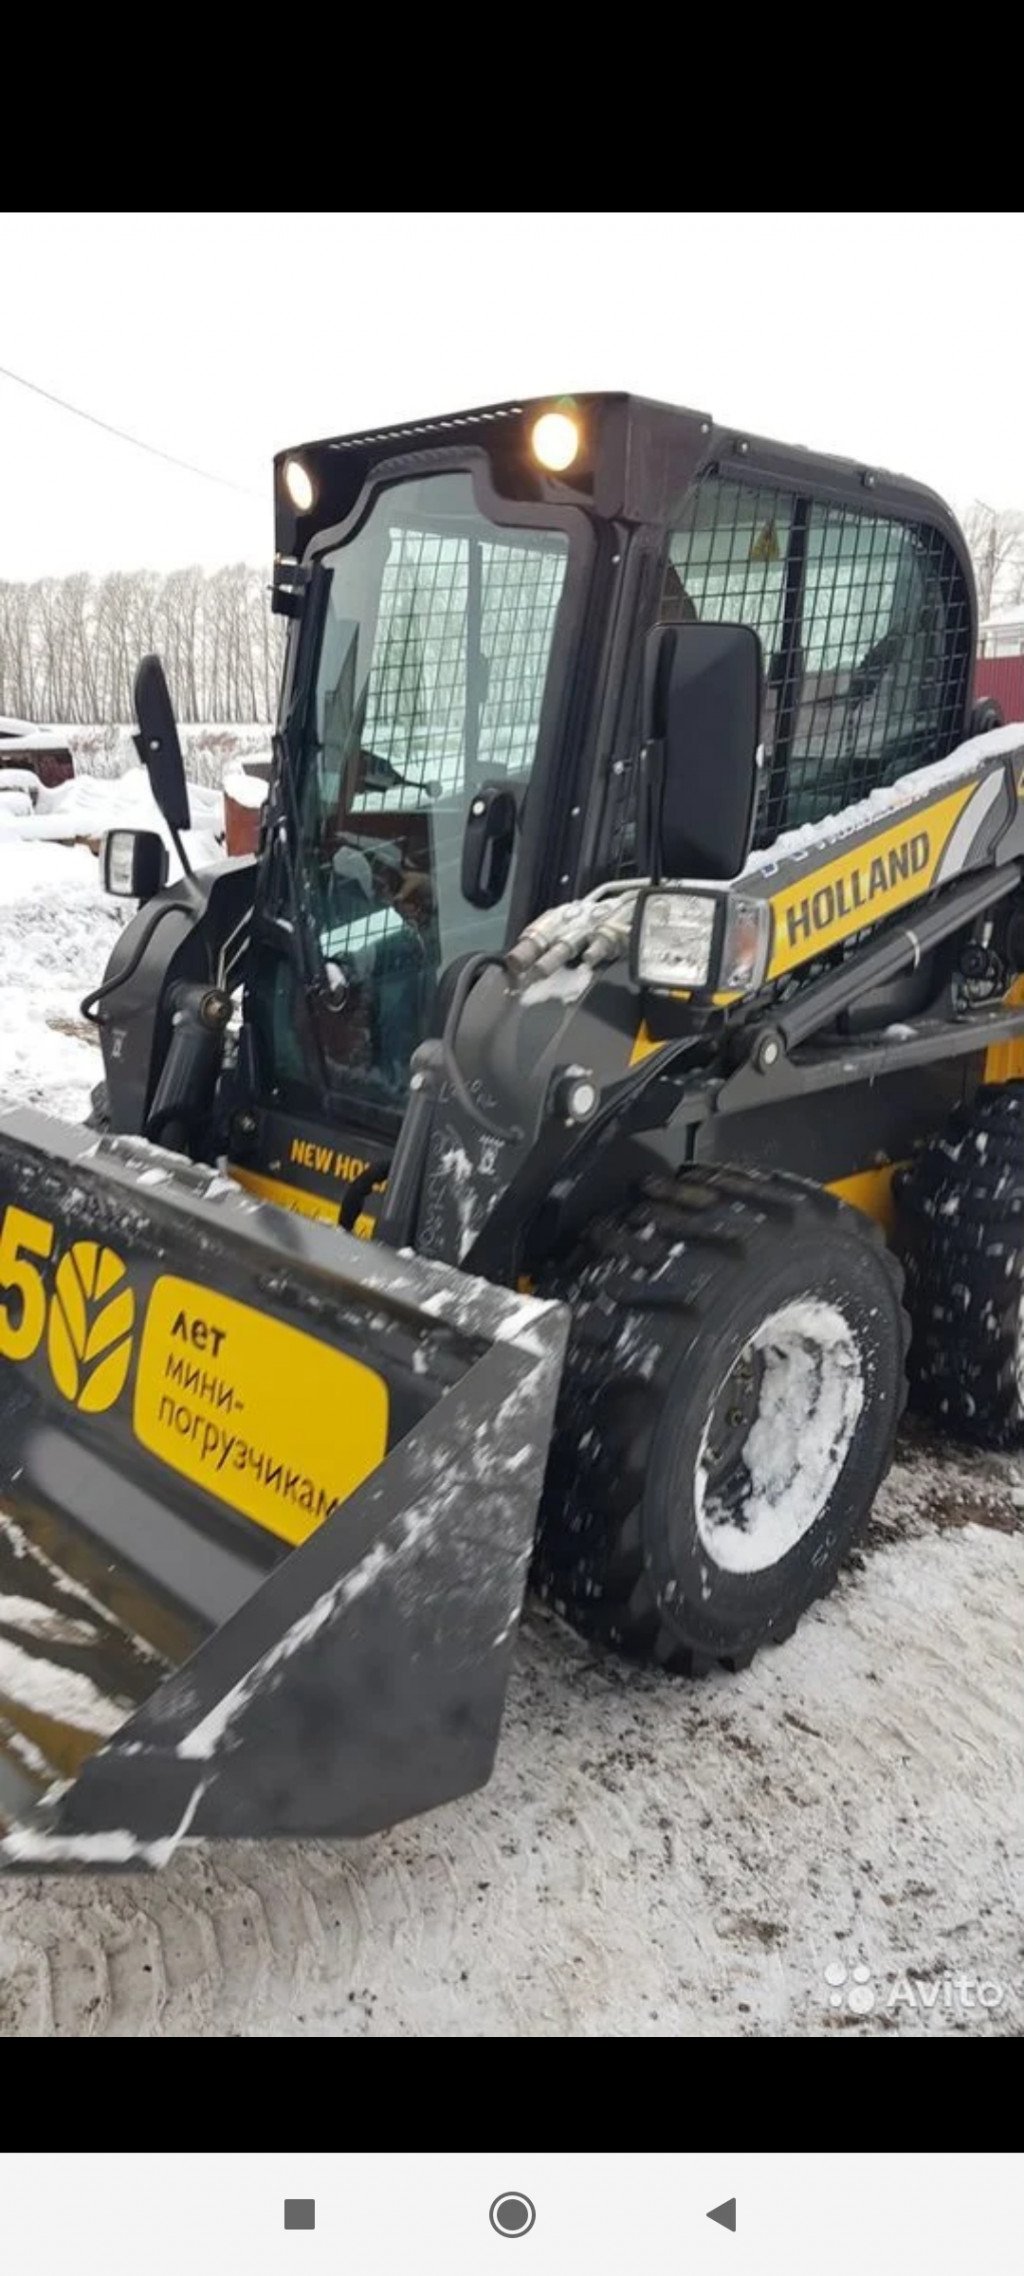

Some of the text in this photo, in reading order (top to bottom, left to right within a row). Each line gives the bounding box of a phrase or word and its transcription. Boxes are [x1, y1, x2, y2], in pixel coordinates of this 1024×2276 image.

[786, 830, 930, 947] HOLLAND
[291, 1139, 334, 1175] NEW
[170, 1309, 226, 1358] лет
[165, 1353, 244, 1414] мини-
